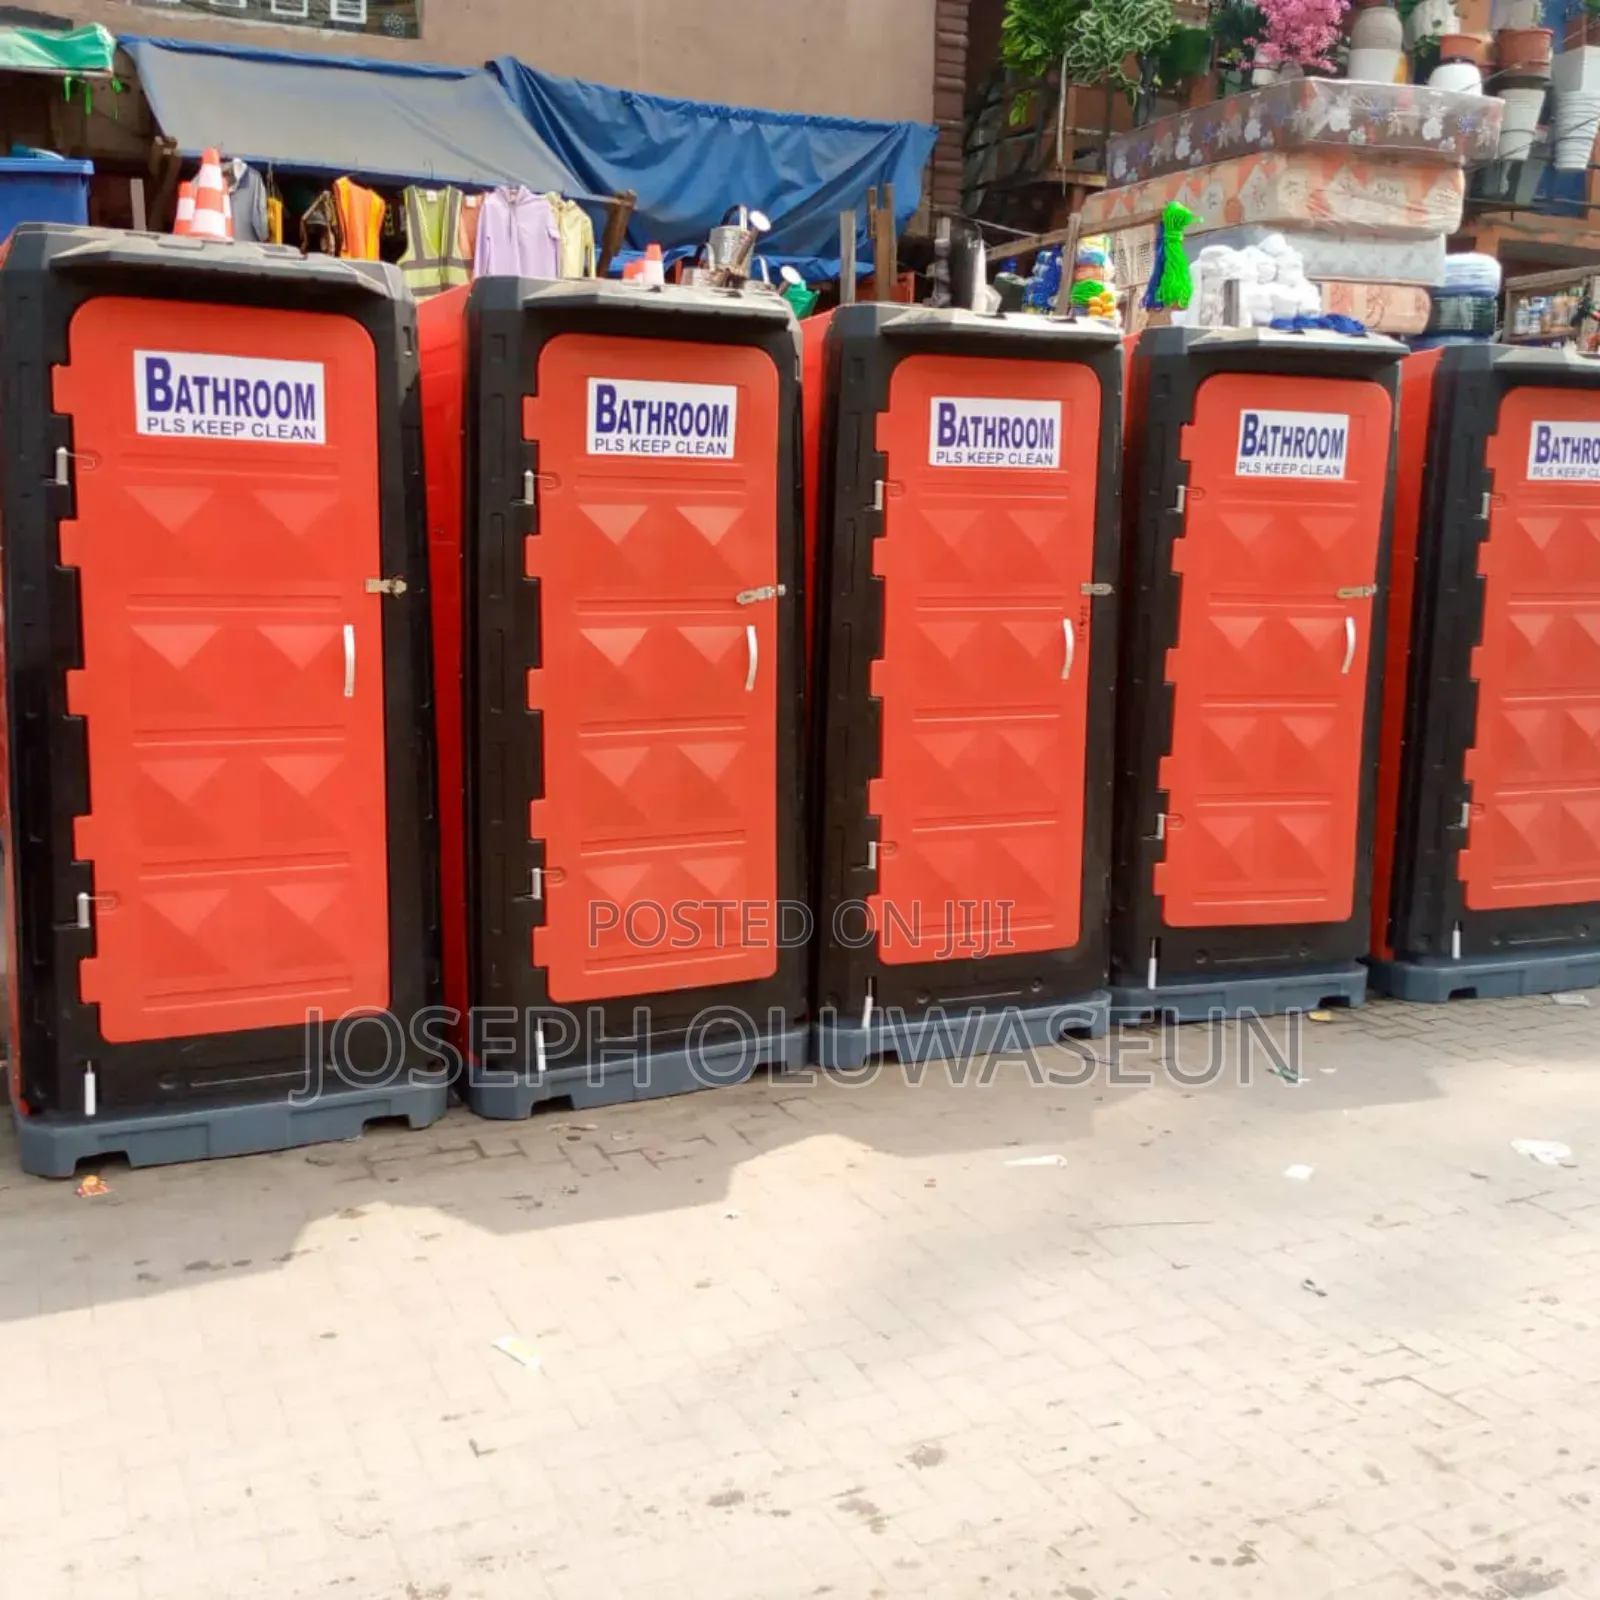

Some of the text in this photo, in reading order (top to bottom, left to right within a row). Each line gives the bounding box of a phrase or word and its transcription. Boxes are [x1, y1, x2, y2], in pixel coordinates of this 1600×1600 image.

[145, 356, 316, 421] BATHROOM
[595, 383, 729, 438] BATHROOM
[937, 402, 1055, 450] BATHROOM
[146, 417, 317, 440] PLS KEEP CLEAN
[1240, 413, 1345, 459] BATHROOM
[594, 438, 728, 455] PLS KEEP CLEAN
[936, 451, 1054, 465] PLS KEEP CLEAN
[1237, 461, 1341, 476] PLS KEEP CLEAN
